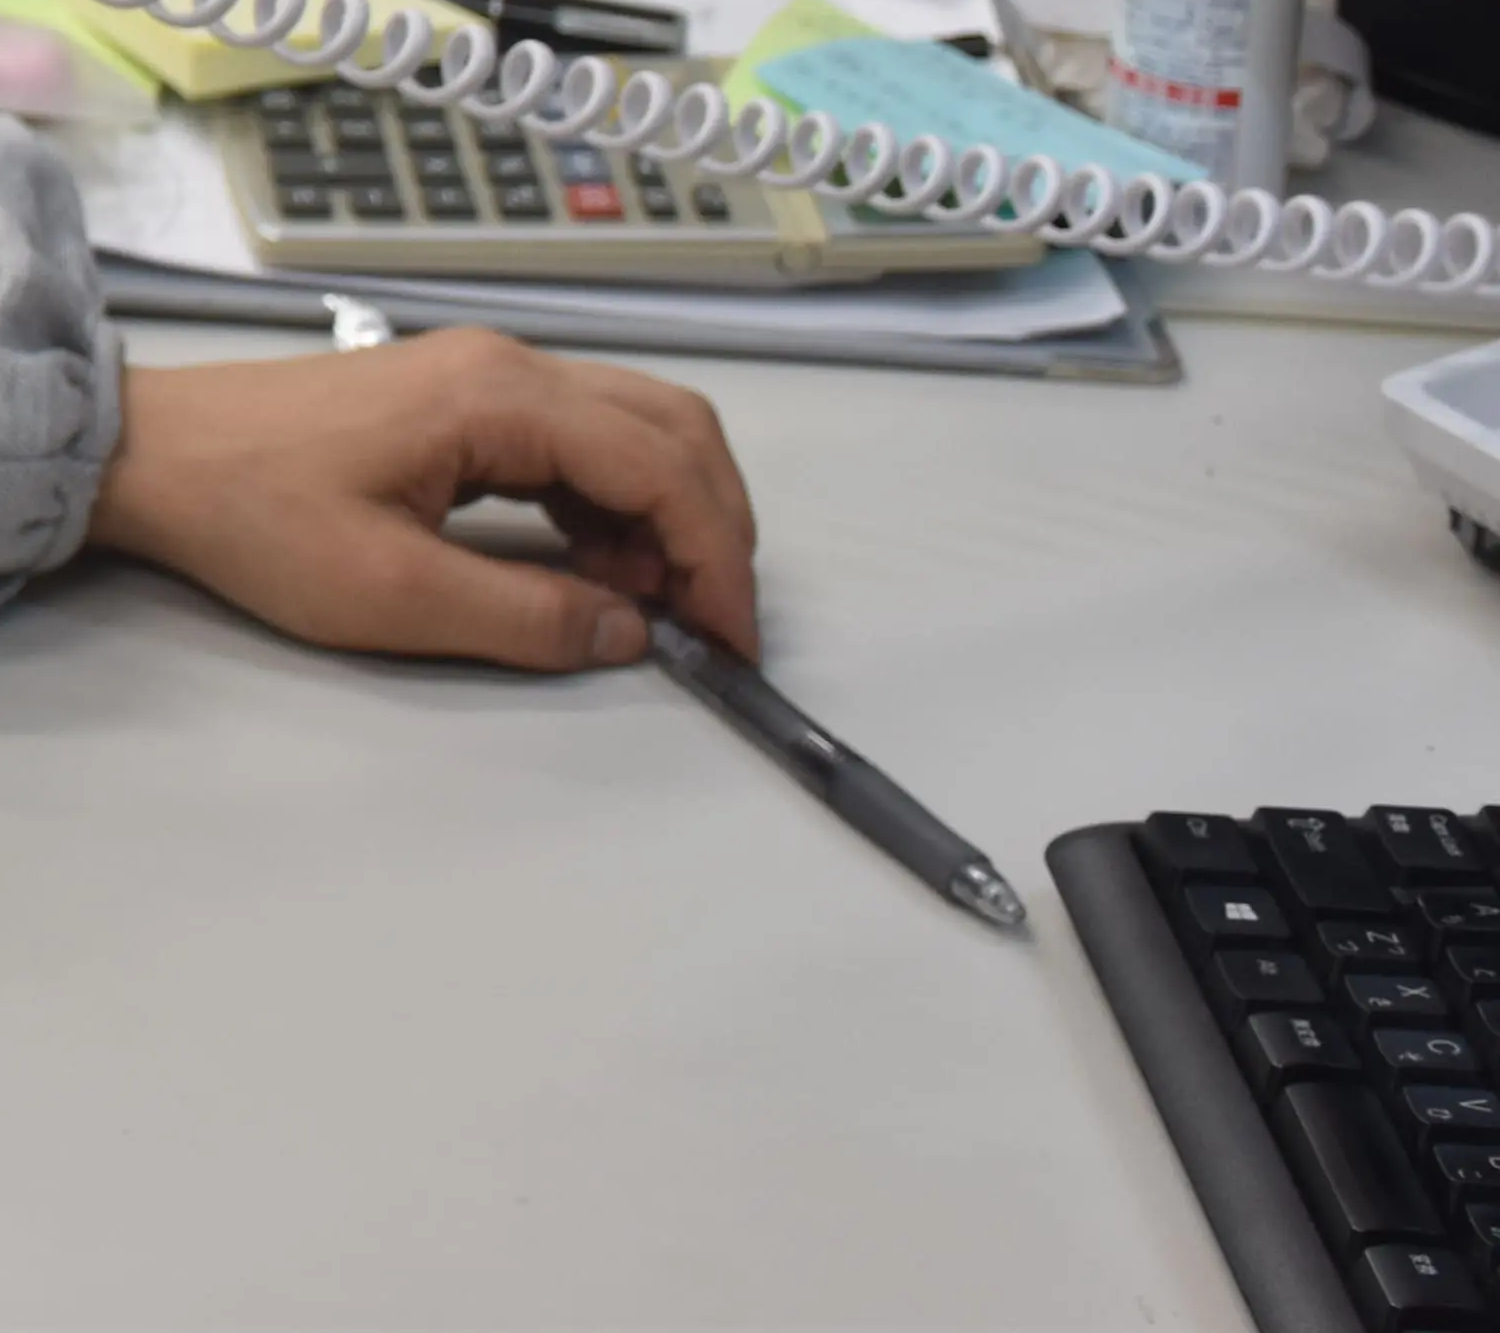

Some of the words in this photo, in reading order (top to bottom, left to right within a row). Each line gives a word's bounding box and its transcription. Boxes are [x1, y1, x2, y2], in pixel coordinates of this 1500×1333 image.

[1366, 930, 1399, 945] Z
[1396, 984, 1431, 999] X
[1426, 1038, 1462, 1057] C
[1459, 1099, 1493, 1113] V
